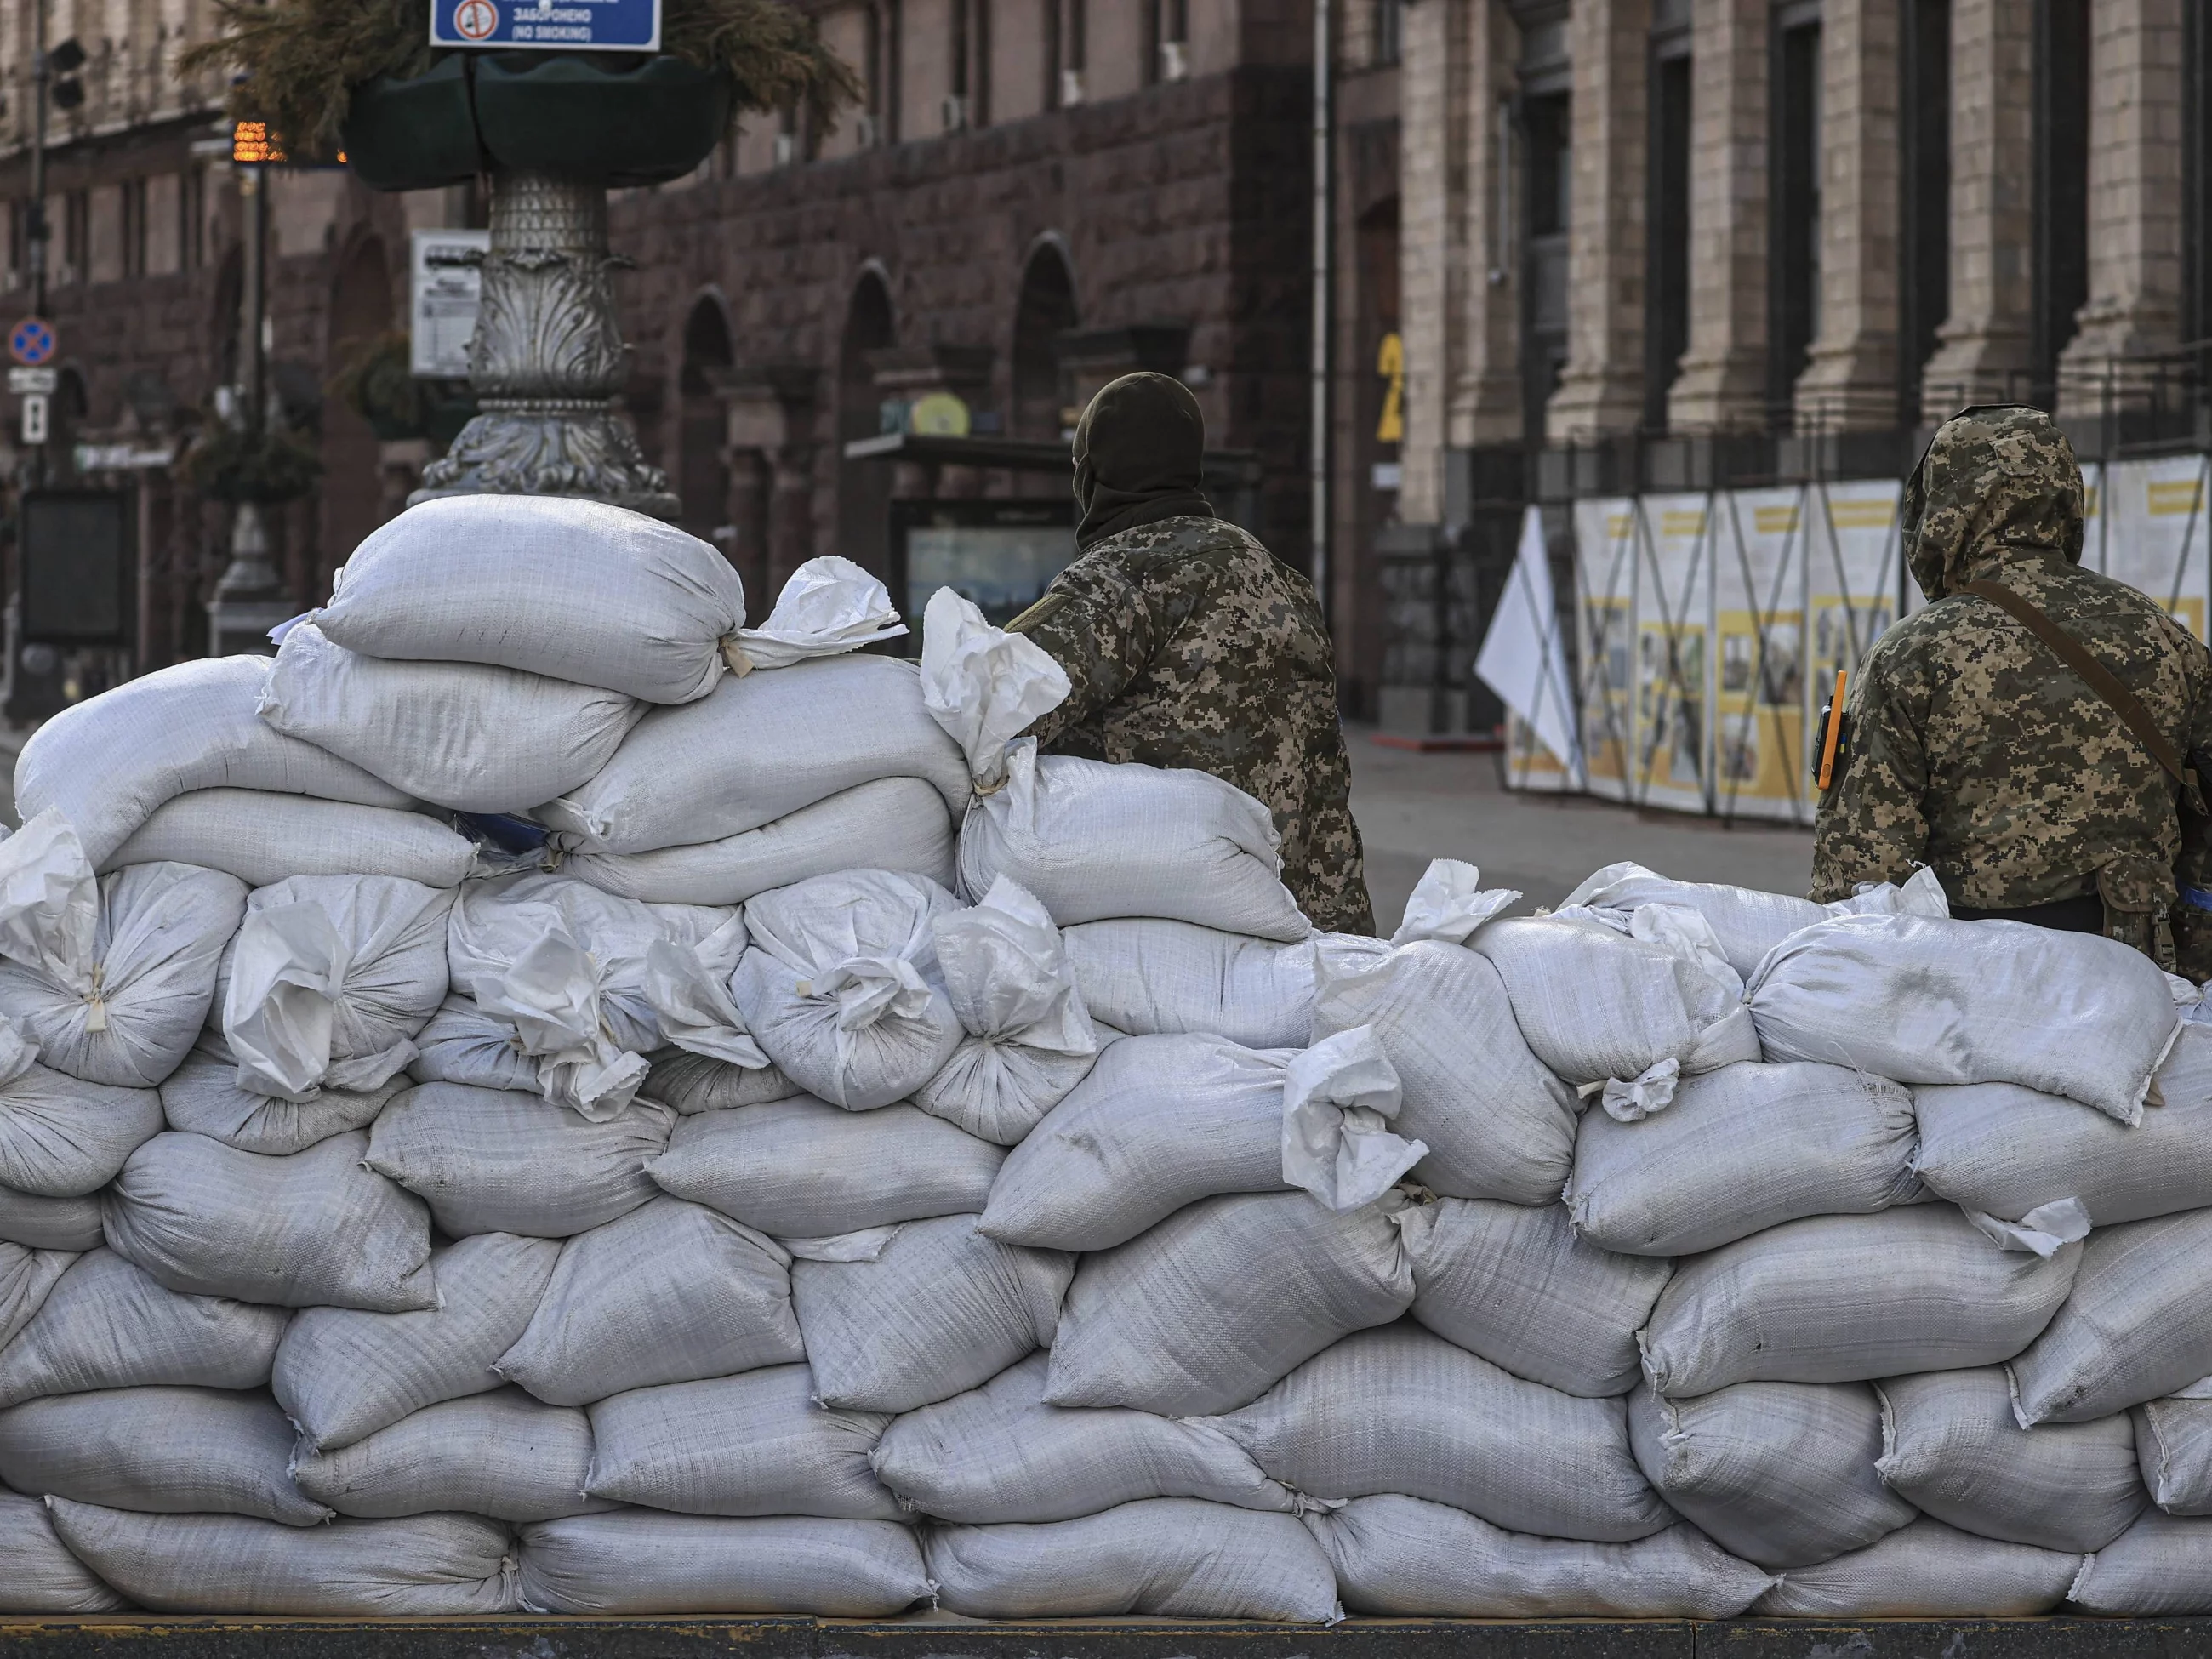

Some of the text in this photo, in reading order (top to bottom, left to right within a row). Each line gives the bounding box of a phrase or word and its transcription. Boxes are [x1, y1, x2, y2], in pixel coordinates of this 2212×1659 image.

[513, 8, 592, 23] ЗАБОРОНЕНО
[512, 26, 592, 42] (NO SMOKING)
